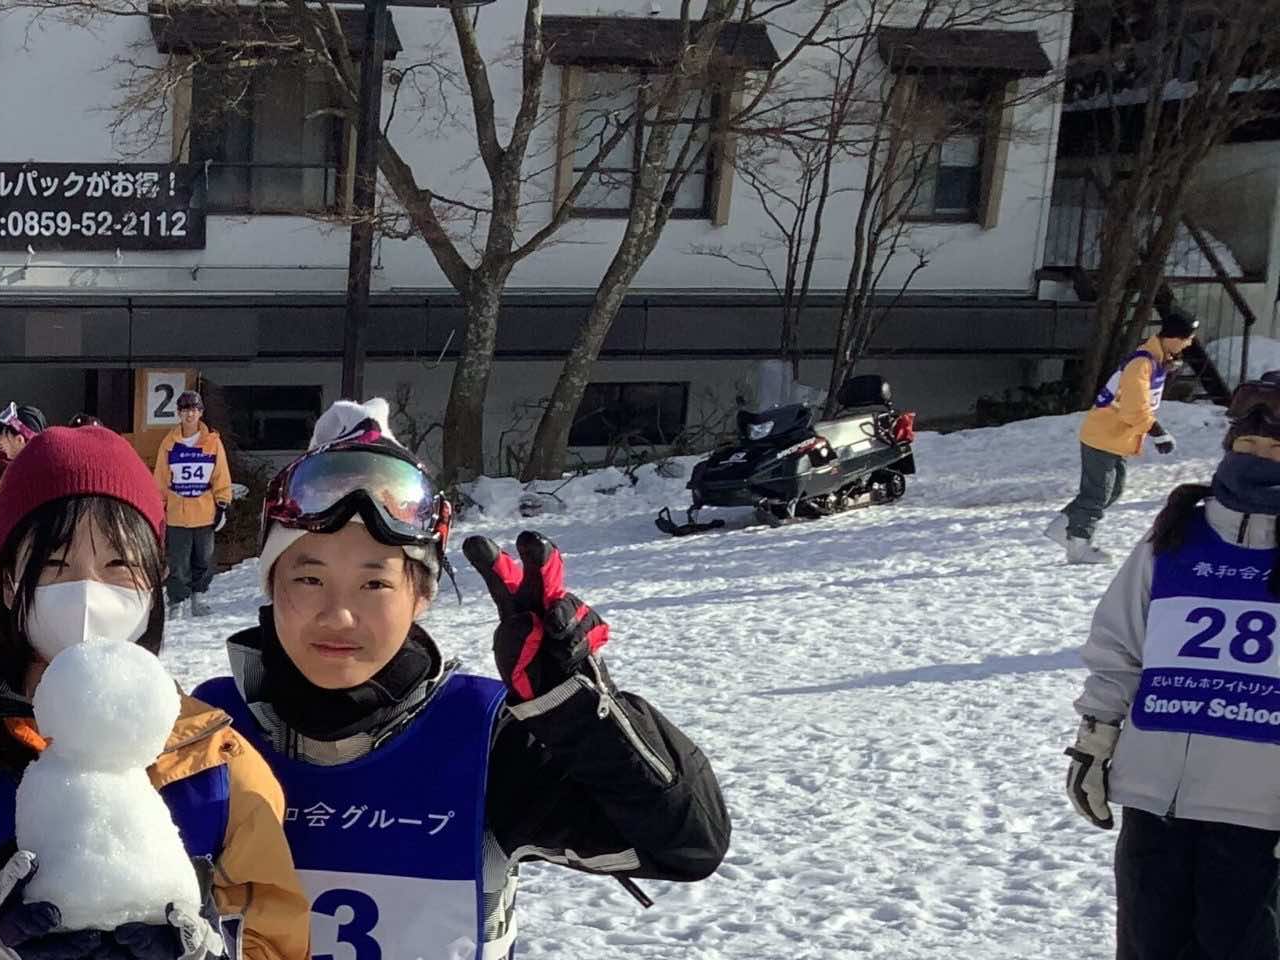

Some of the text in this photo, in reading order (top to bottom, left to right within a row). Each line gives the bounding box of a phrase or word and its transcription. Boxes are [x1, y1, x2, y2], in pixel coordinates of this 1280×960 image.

[154, 384, 175, 418] 2
[181, 466, 204, 480] 54
[1177, 607, 1276, 663] 28
[1144, 694, 1203, 714] Snow
